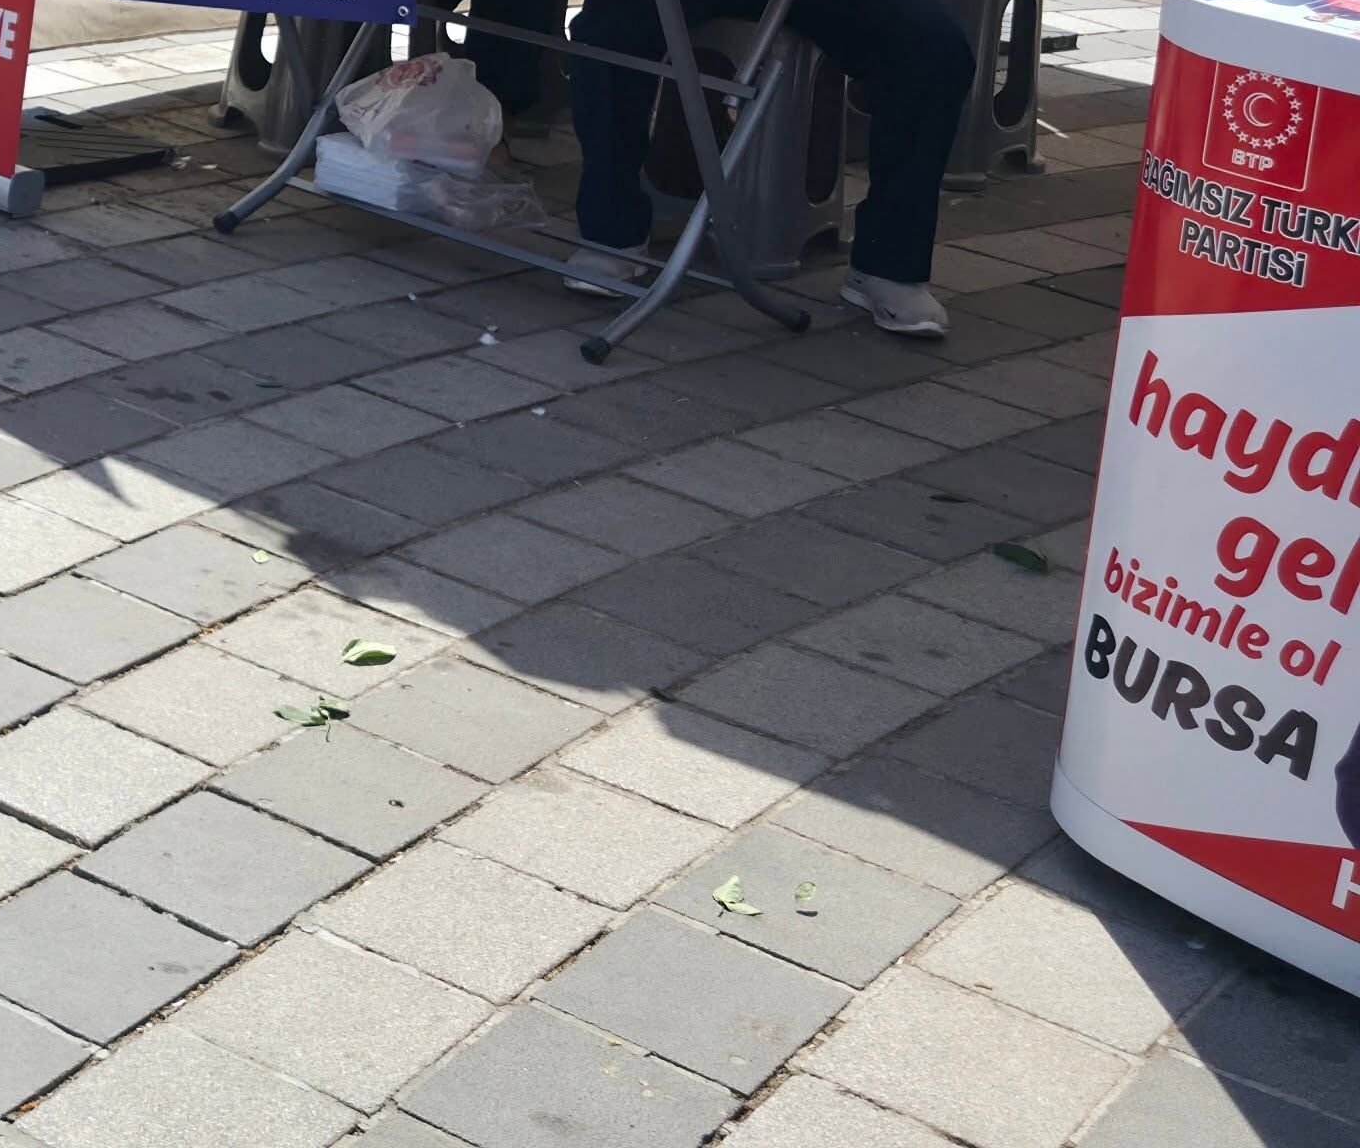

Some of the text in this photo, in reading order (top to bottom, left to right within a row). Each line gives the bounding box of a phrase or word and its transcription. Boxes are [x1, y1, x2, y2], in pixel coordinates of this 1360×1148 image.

[1142, 149, 1360, 256] BAĞIMSIZ TÜRK
[1231, 148, 1274, 171] BTP
[1129, 350, 1360, 508] hayd
[1104, 546, 1342, 686] bizimle ol
[1085, 614, 1318, 781] BURSA
